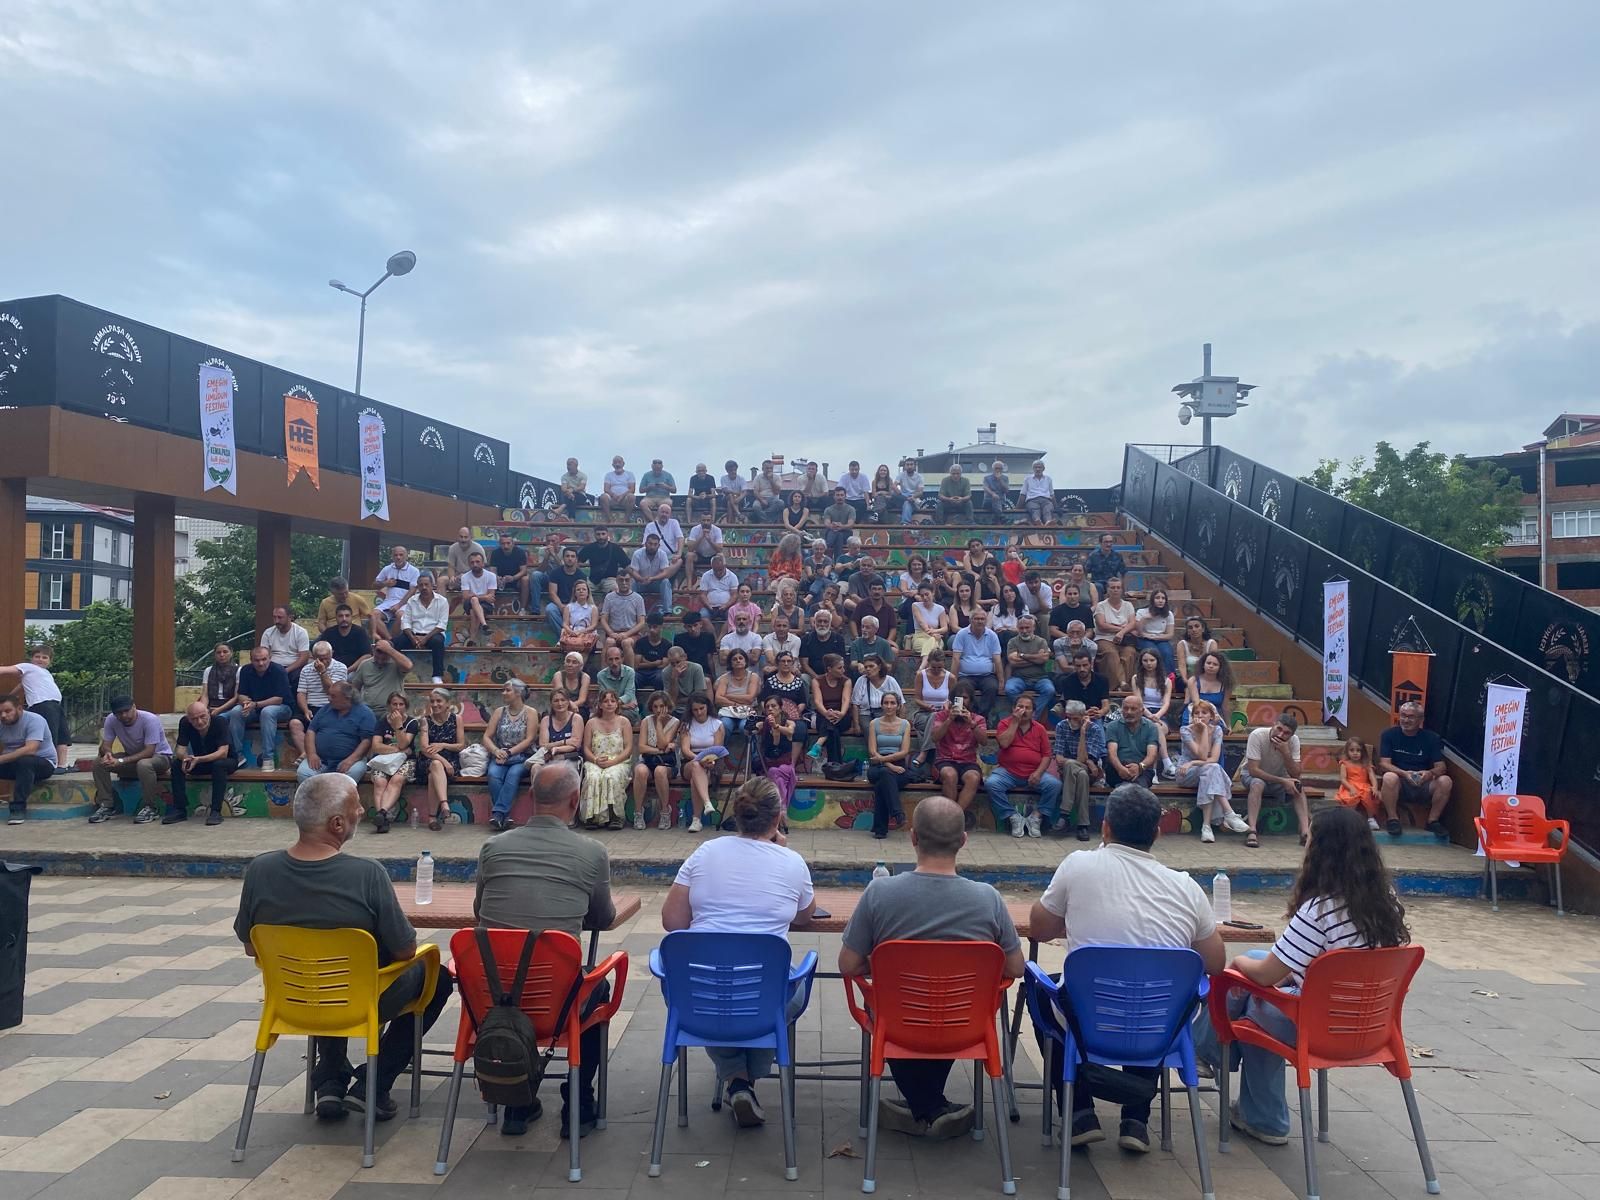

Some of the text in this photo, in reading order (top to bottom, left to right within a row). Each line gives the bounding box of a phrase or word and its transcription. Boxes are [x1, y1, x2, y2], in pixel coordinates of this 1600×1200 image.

[92, 324, 125, 346] KEMALPAŞA
[288, 424, 314, 445] HE
[1494, 699, 1520, 717] EMEĞİN
[1499, 714, 1507, 723] VE
[1492, 720, 1517, 737] UMUDUN
